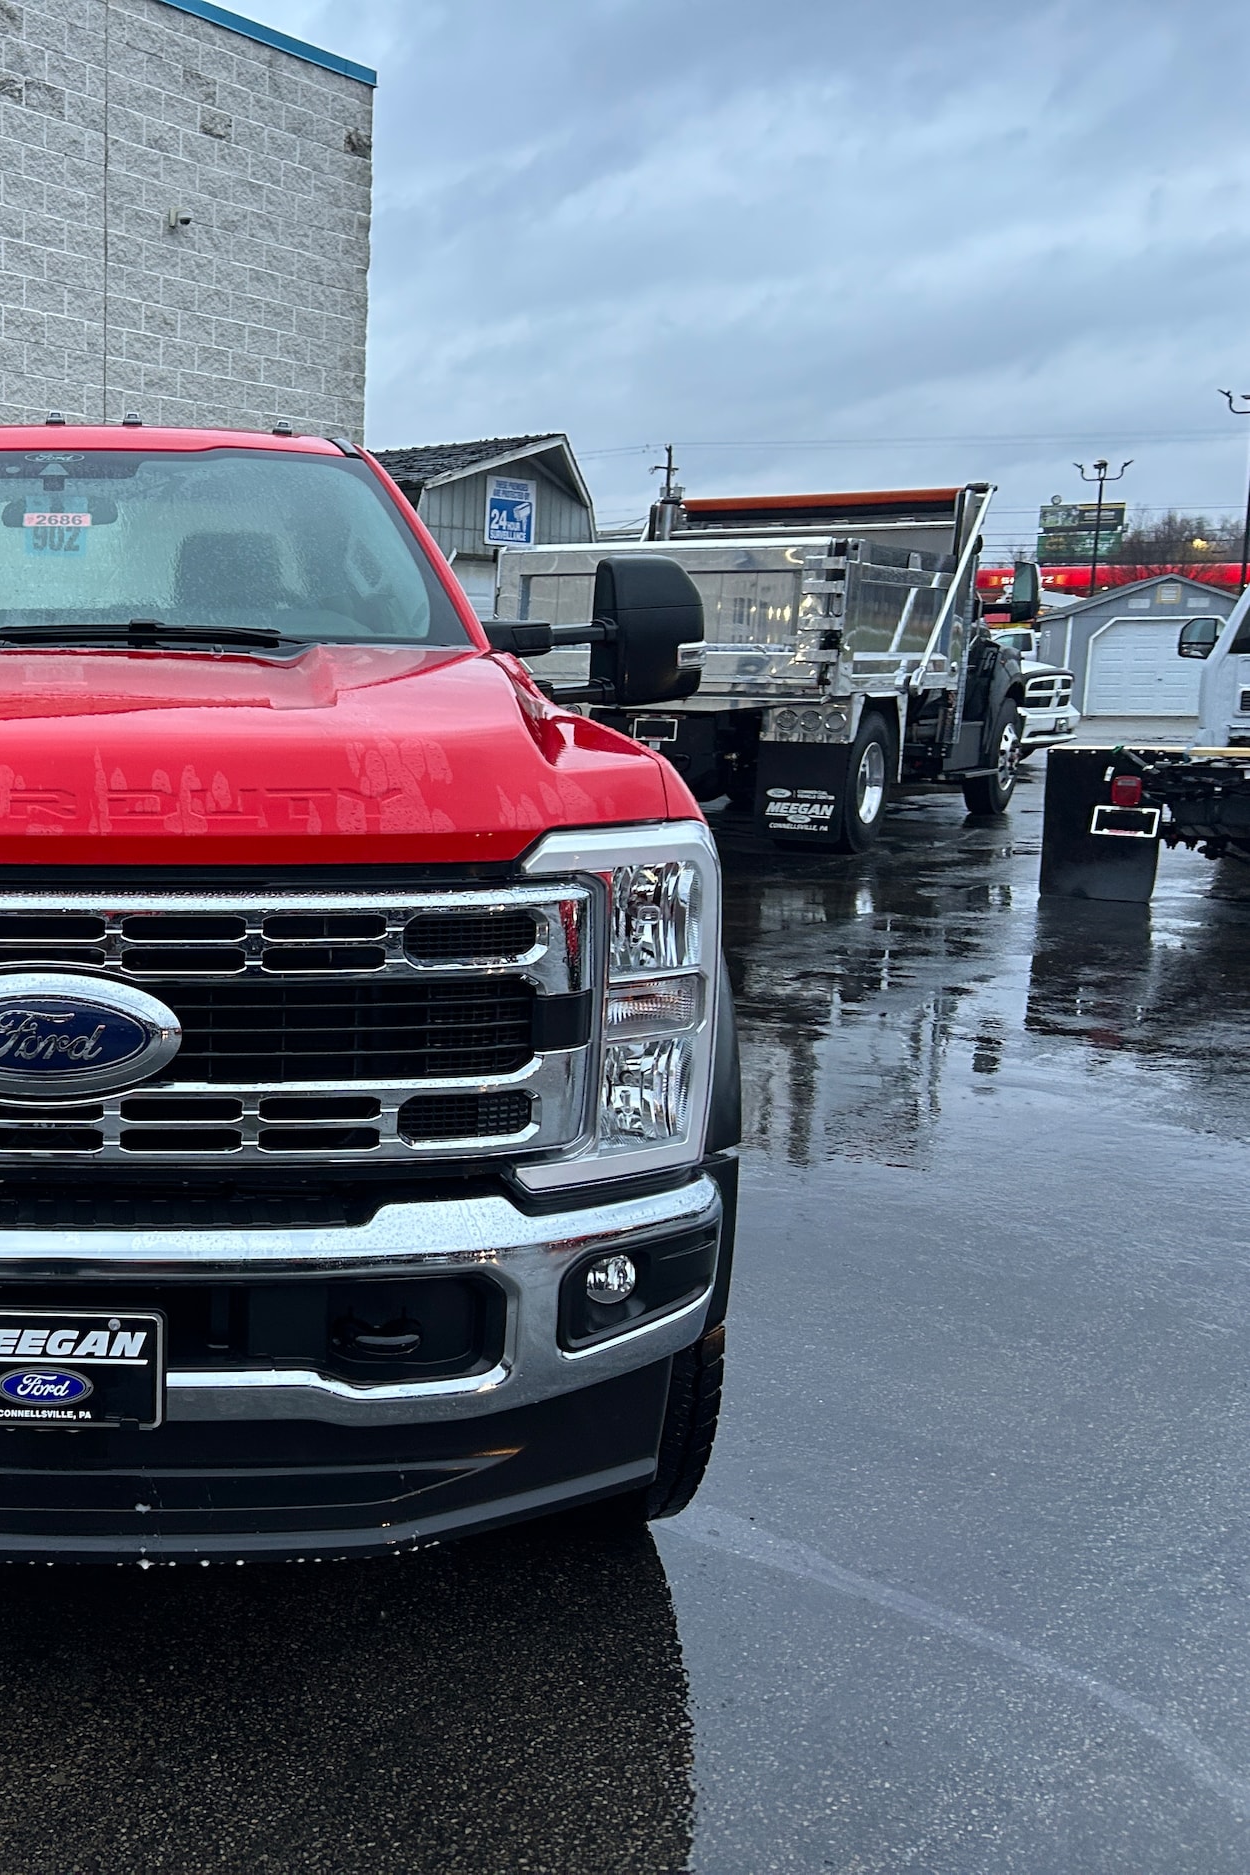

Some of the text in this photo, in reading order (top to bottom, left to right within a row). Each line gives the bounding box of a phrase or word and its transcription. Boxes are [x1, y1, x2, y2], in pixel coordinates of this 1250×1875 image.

[35, 514, 83, 525] 2686
[491, 509, 522, 532] 24 HOUR
[33, 526, 81, 551] 902
[765, 801, 834, 816] MEEGAN
[16, 1373, 69, 1397] Ford
[78, 1411, 92, 1419] PA
